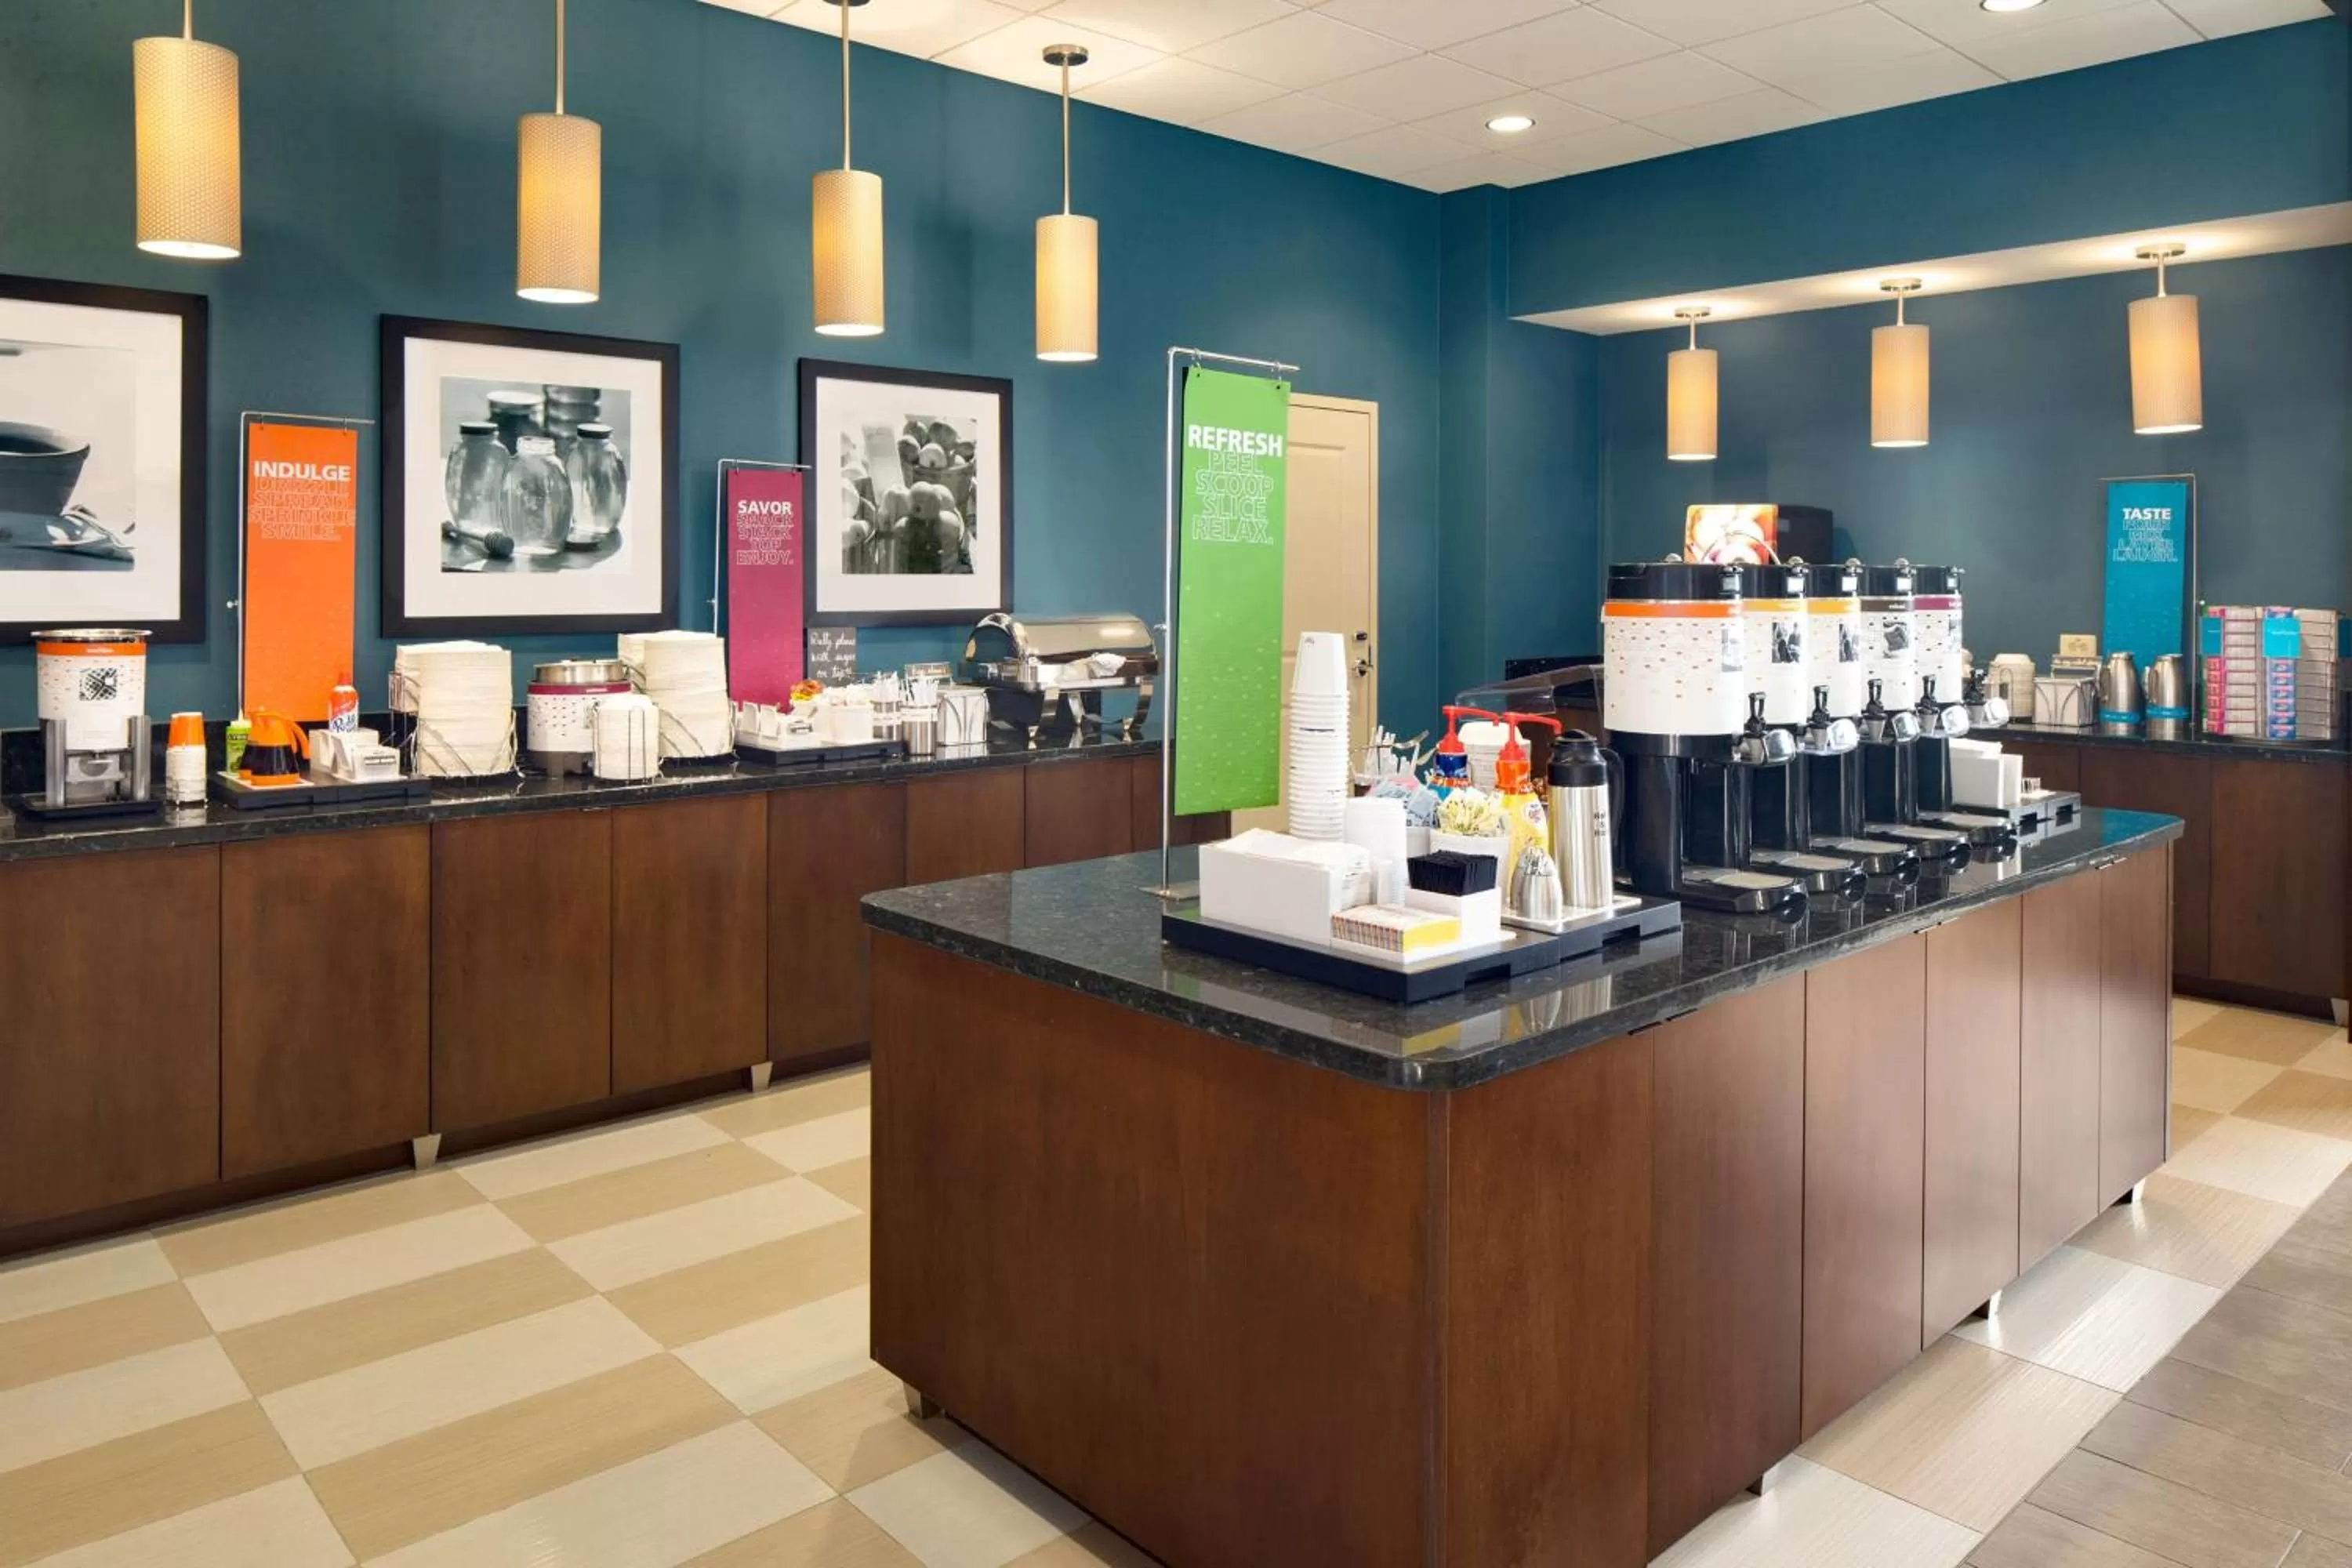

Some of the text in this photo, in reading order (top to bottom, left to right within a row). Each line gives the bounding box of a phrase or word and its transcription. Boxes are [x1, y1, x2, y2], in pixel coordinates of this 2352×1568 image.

[1188, 424, 1283, 457] REFRESH
[254, 460, 351, 481] INDULGE
[1208, 449, 1265, 475] PEEL
[1195, 470, 1274, 497] SCOOP
[738, 499, 792, 515] SAVOR
[1203, 494, 1268, 519] SLICE
[2122, 507, 2172, 520] TASTE
[1192, 514, 1274, 545] RELAX.
[736, 550, 794, 565] ENJOY.
